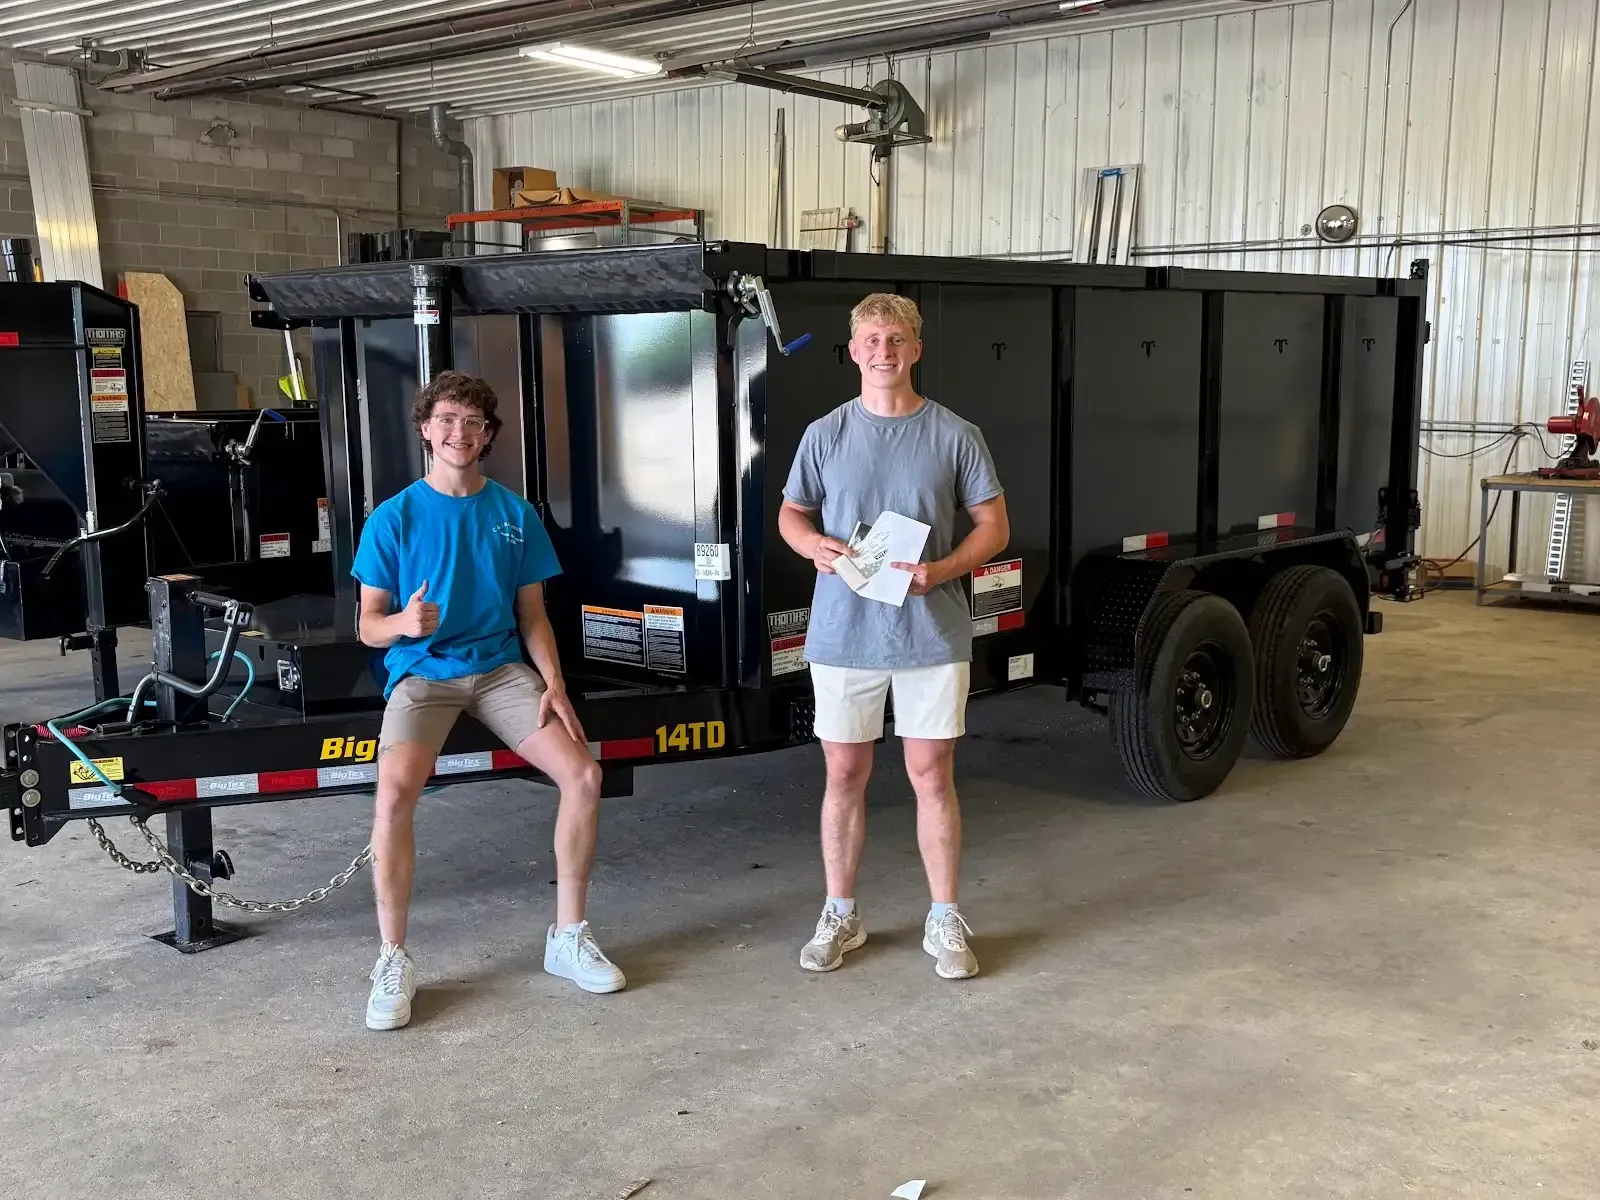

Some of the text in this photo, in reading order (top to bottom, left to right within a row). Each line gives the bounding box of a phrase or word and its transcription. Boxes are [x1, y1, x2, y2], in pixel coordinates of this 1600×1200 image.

[88, 329, 124, 339] THOMAS
[696, 544, 719, 558] 89260
[990, 563, 1012, 574] DANGER
[655, 607, 677, 616] WARNING
[769, 610, 808, 627] THOMAS
[320, 720, 726, 763] Big 14TD
